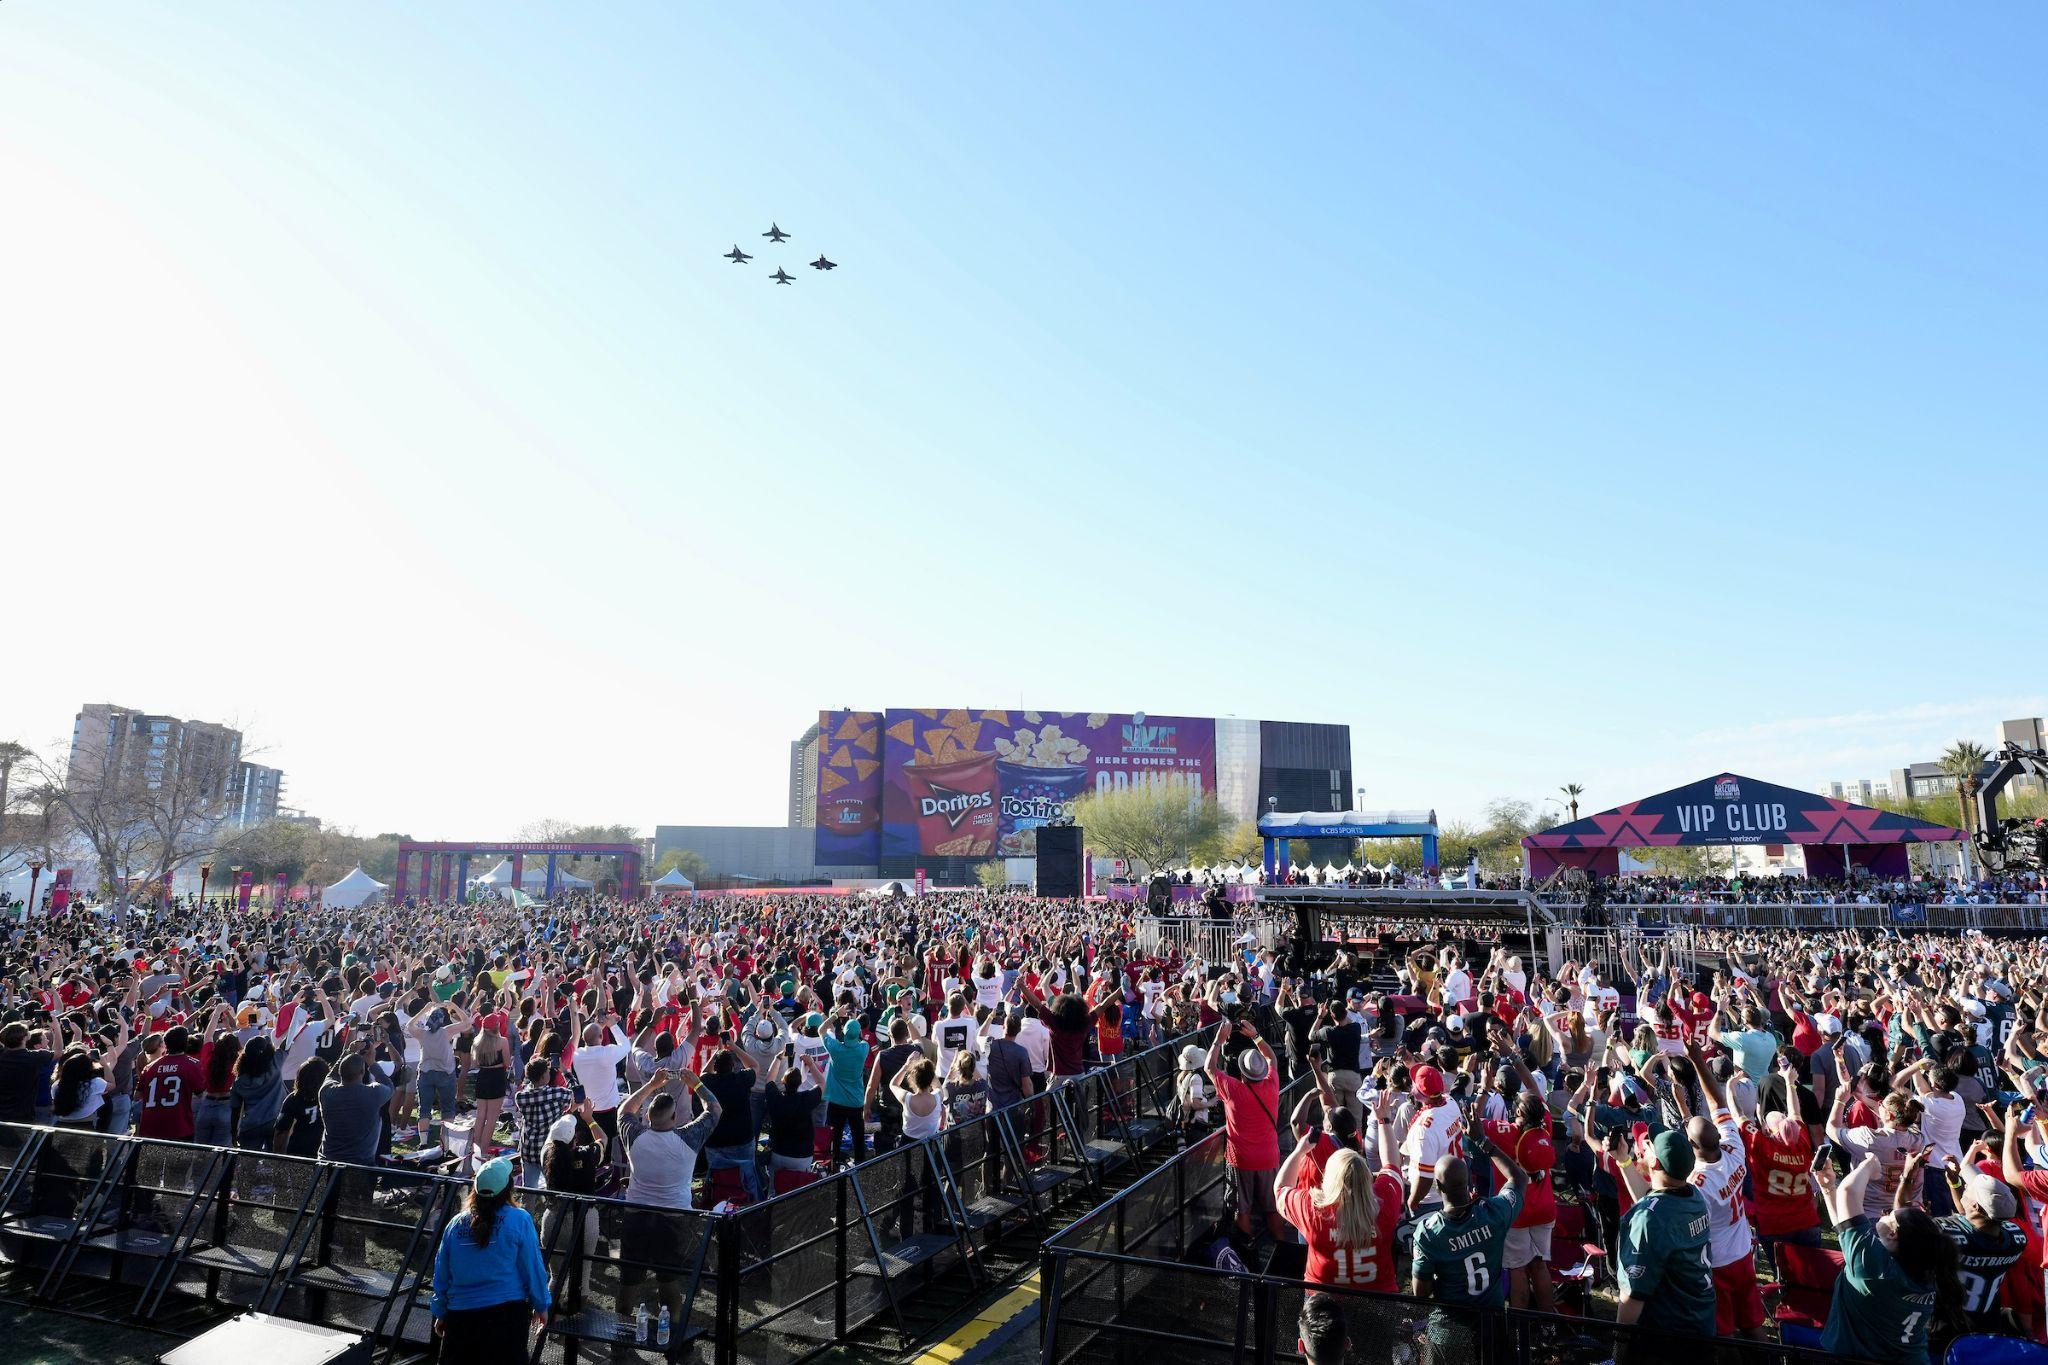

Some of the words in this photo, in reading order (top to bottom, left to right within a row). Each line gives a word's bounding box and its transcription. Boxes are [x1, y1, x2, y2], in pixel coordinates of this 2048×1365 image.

[1095, 756, 1128, 765] HERE
[1133, 757, 1174, 766] COMES
[1179, 758, 1201, 767] THE
[921, 791, 992, 816] Doritos
[1676, 804, 1715, 832] VIP
[1726, 803, 1788, 832] CLUB
[1730, 834, 1761, 842] verizon
[157, 1064, 178, 1074] EVANS
[145, 1075, 182, 1108] 13
[1719, 1164, 1747, 1201] MAHOMES
[1647, 1197, 1660, 1212] 1
[1448, 1224, 1493, 1252] SMITH
[1333, 1247, 1378, 1284] 15
[1464, 1251, 1490, 1296] 6
[1901, 1311, 1922, 1344] 1
